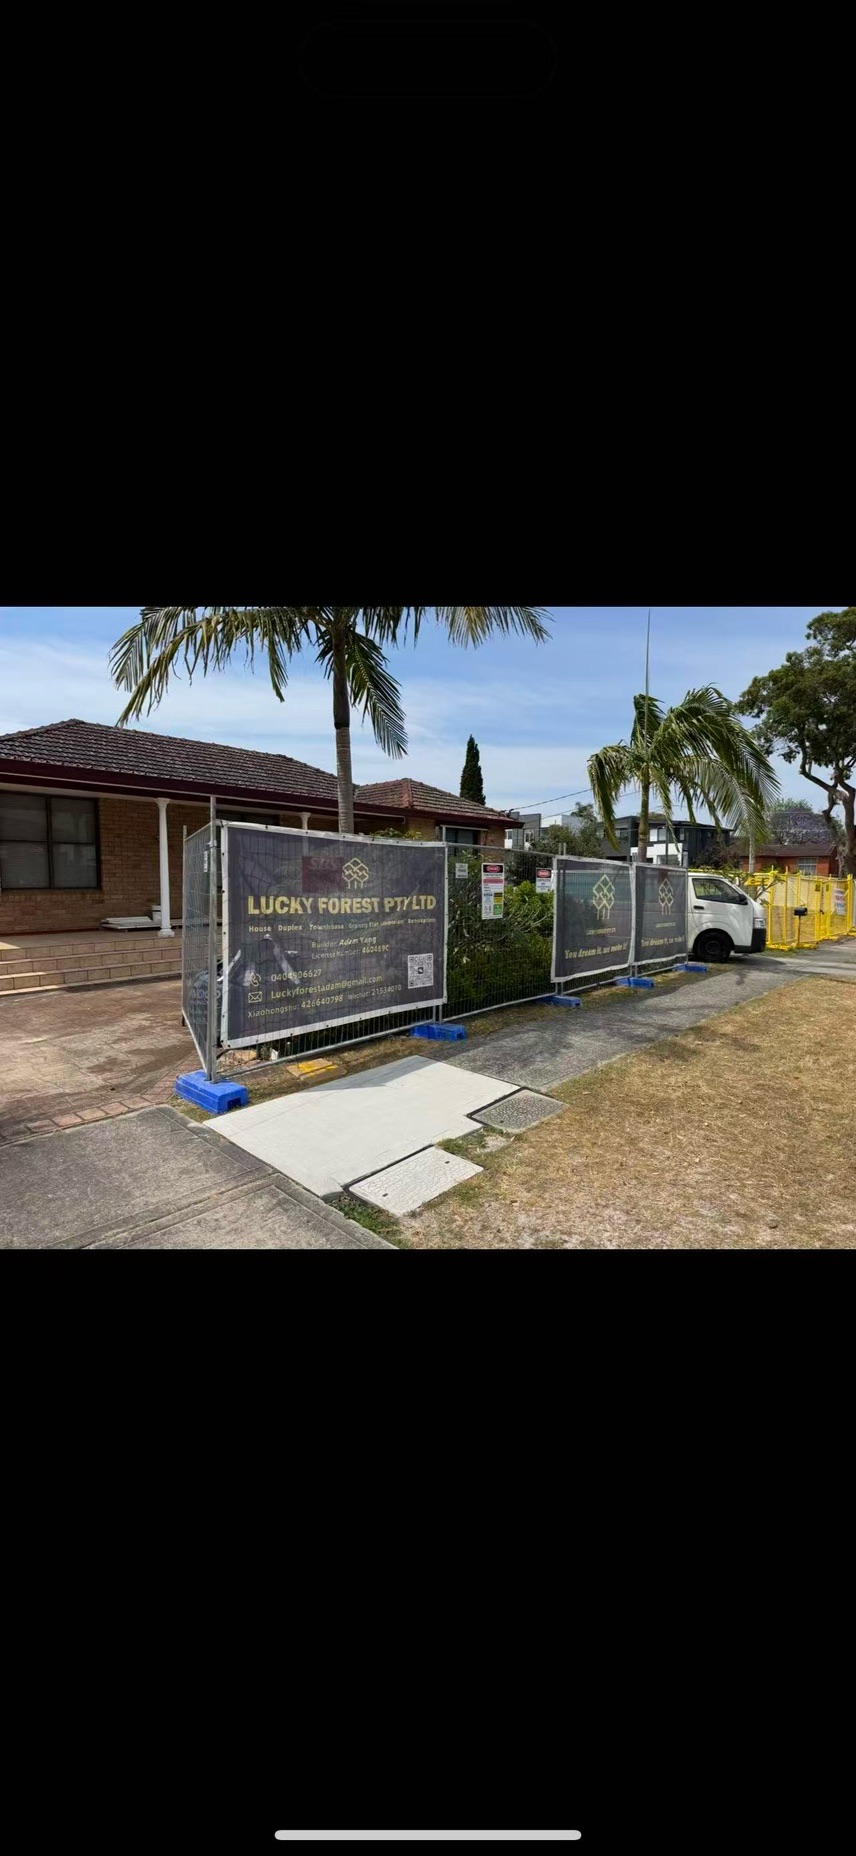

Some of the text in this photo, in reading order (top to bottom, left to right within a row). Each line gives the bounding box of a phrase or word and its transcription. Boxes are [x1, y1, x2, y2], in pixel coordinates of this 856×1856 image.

[248, 895, 437, 915] LUCKY FOREST PTY LTD
[248, 925, 272, 933] House
[278, 924, 303, 932] Duplex
[339, 938, 359, 947] Adam
[359, 936, 377, 946] Yang
[270, 968, 322, 982] 0404906627
[270, 975, 383, 999] Luckyforestadam@gmail.com
[301, 995, 344, 1009] 426640798
